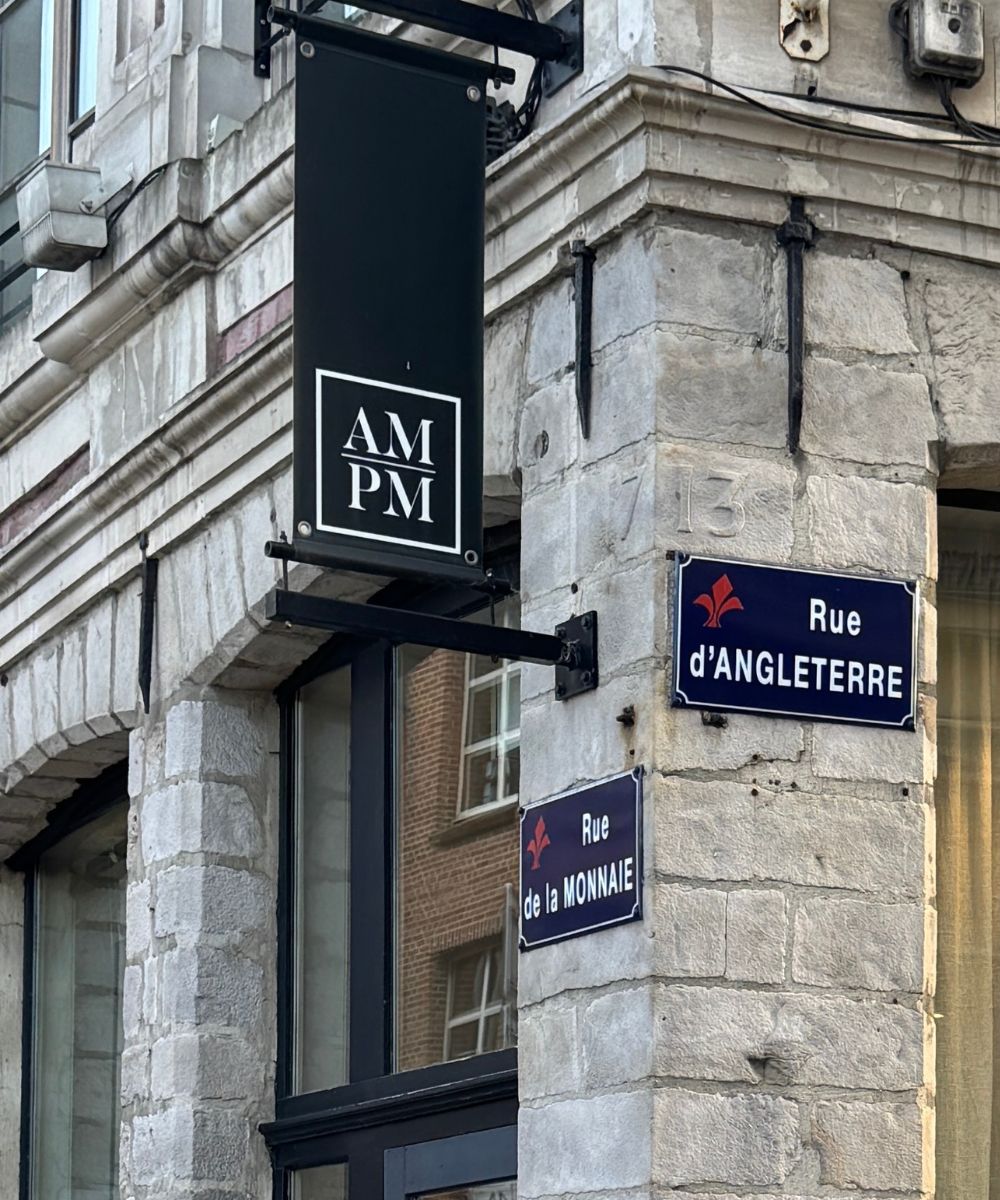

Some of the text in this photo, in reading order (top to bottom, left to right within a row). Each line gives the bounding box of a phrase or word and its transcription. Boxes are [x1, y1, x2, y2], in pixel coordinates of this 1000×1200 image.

[342, 406, 435, 465] AM
[348, 462, 435, 523] PM
[809, 597, 862, 636] Rue
[689, 644, 903, 699] d'ANGLETERRE
[582, 813, 609, 846] Rue
[524, 857, 633, 920] de la MONNAIE
